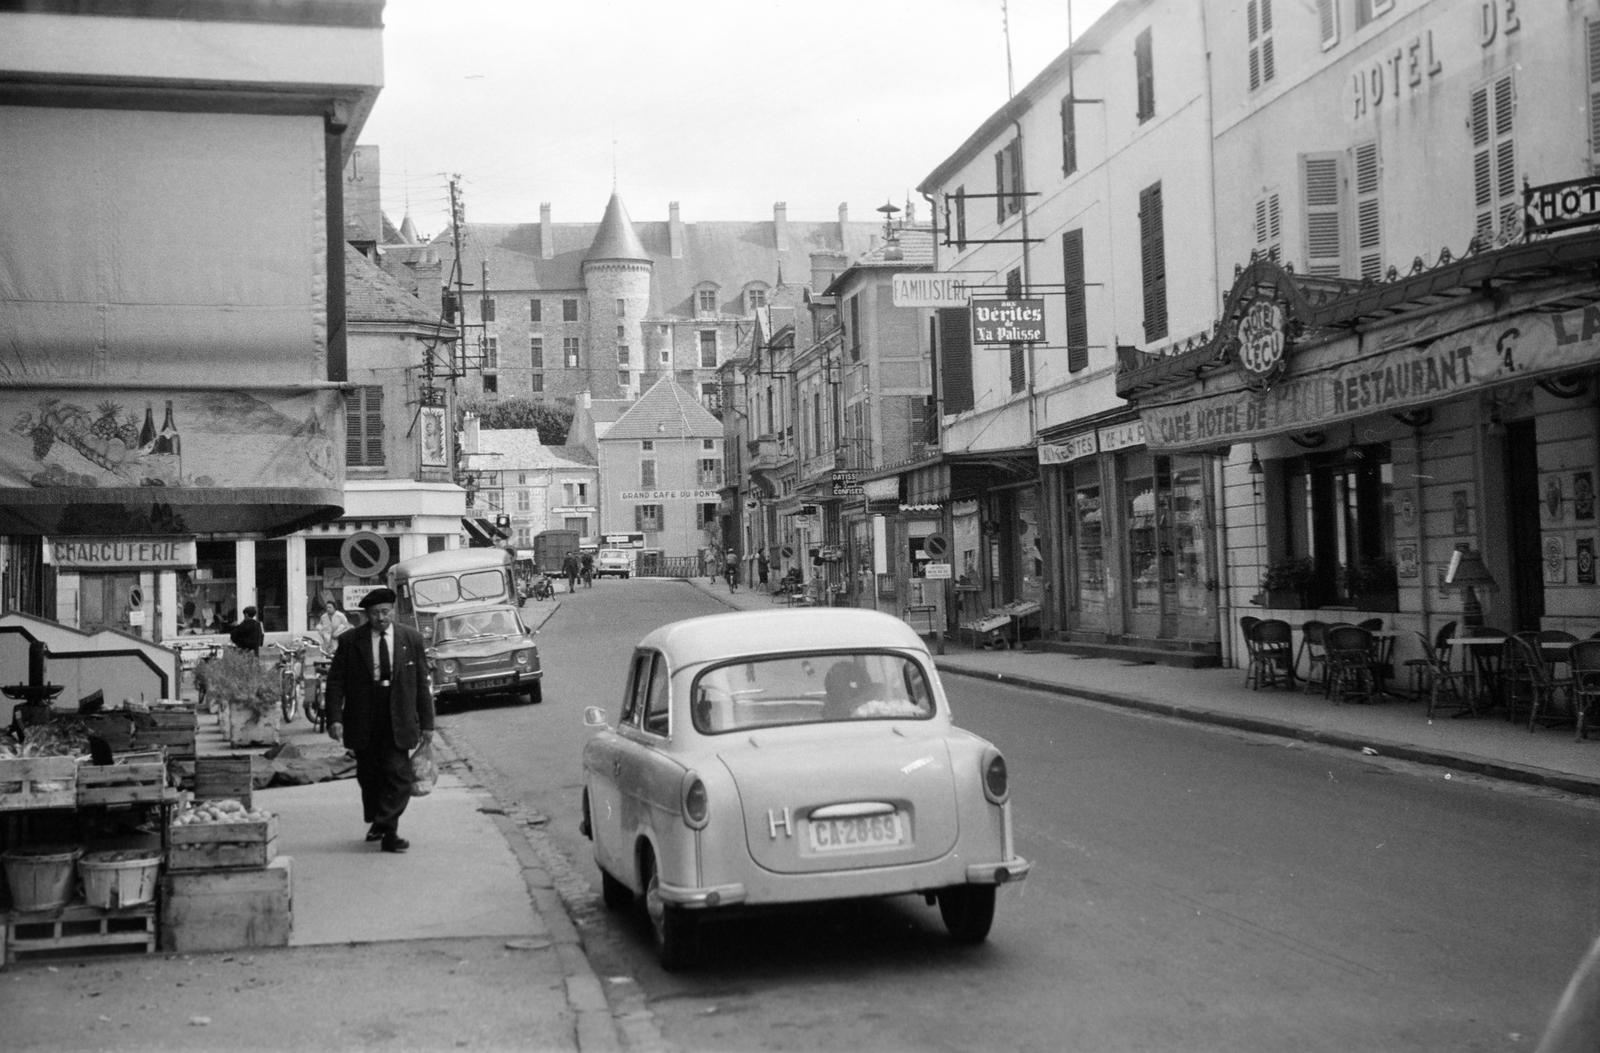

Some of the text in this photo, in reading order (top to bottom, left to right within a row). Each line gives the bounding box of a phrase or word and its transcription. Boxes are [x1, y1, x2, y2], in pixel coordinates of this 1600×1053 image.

[1352, 0, 1521, 120] HOTEL DE
[1197, 403, 1241, 440] HOTEL
[1333, 345, 1473, 414] RESTAURANT
[622, 492, 650, 500] GRAND
[694, 490, 715, 498] PONT
[54, 542, 181, 562] CHARCUTERIE
